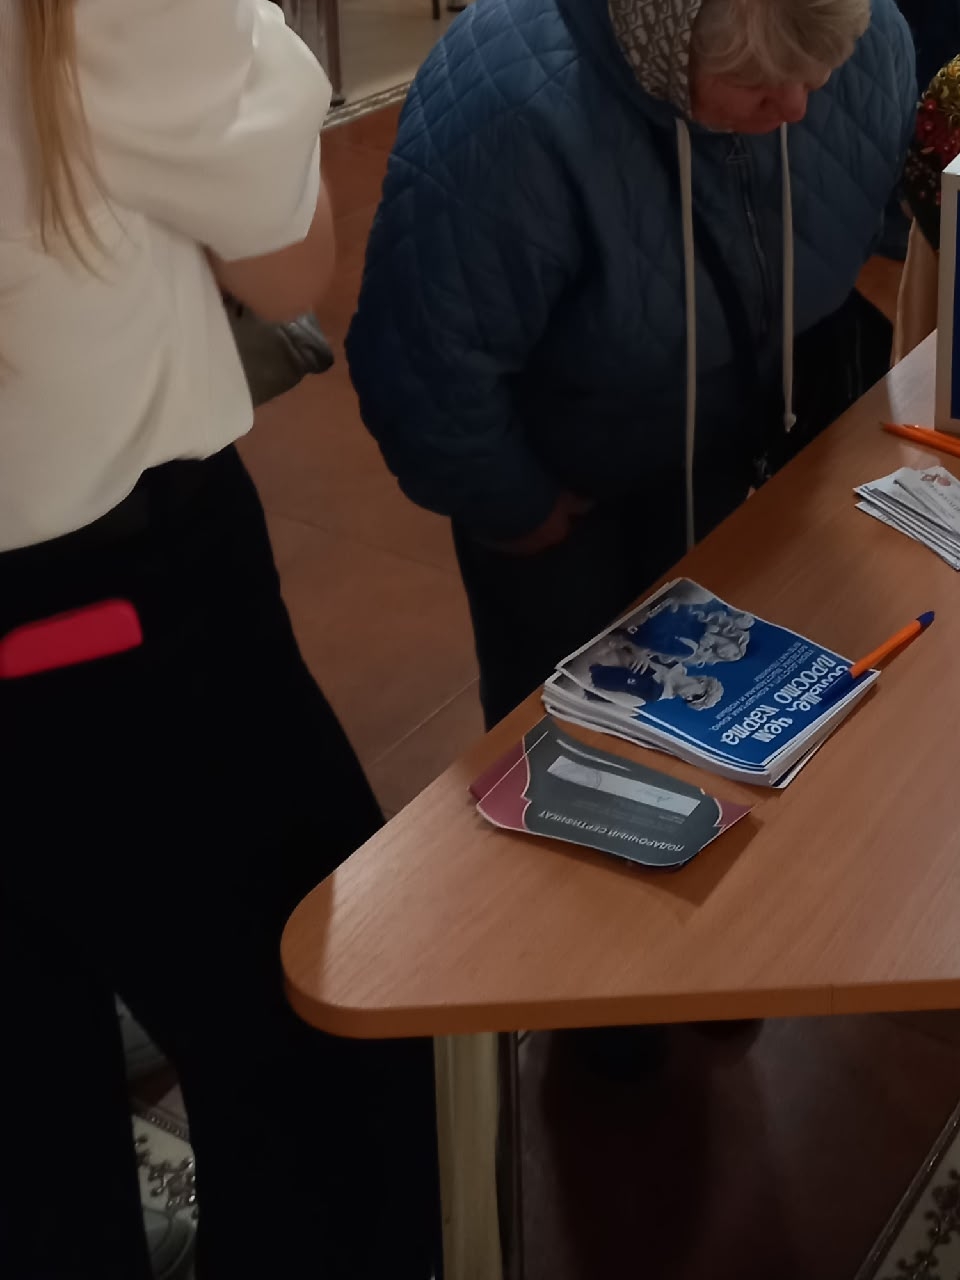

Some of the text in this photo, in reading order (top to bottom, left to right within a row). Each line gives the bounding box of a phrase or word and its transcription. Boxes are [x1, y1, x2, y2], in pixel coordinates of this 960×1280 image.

[773, 654, 837, 704] просто
[538, 810, 685, 852] ПОДАРОЧНЫЙ СЕРТИФИКАТ
